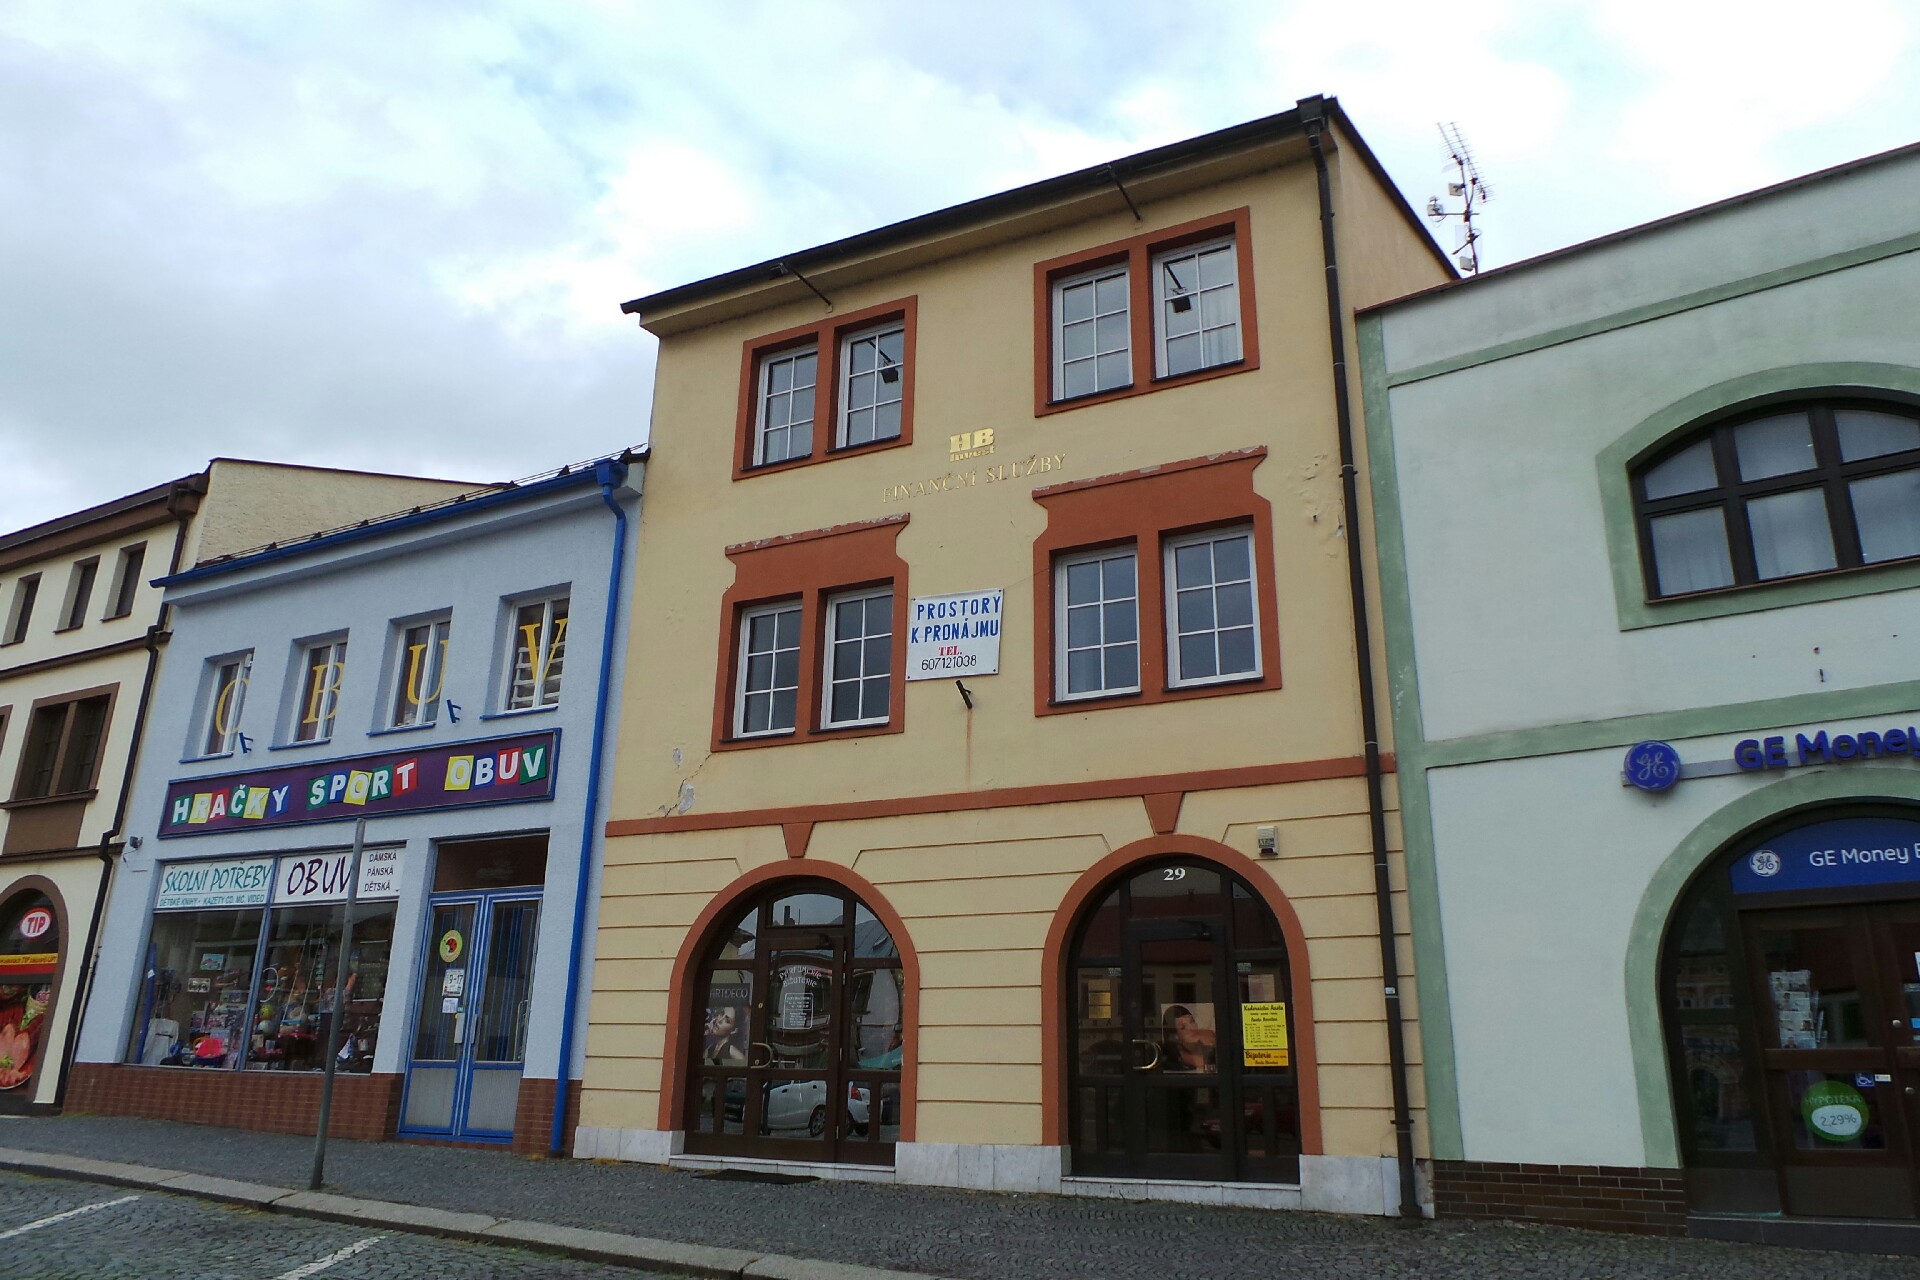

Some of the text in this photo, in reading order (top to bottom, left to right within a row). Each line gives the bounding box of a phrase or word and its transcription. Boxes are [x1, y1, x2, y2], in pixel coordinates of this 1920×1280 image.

[950, 428, 995, 453] HB
[882, 453, 1067, 503] FINANČNÍ SLUŽBY
[917, 596, 1001, 620] PROSTORY
[911, 617, 999, 644] K PRONÁJMU
[938, 645, 963, 656] TEL.
[921, 654, 977, 671] 607121038
[1734, 736, 1788, 770] GE
[171, 747, 545, 824] HRAČKY SPORT OBUV
[369, 849, 397, 862] DÁMSKÁ
[1809, 850, 1837, 867] GE
[1842, 843, 1909, 865] Money
[163, 860, 272, 894] ŠKOLNÍ POTŘEBY
[287, 855, 353, 896] OBUV
[367, 865, 394, 877] PÁNSKÁ
[1163, 867, 1186, 881] 29
[363, 880, 391, 893] DĚTSKÁ
[27, 916, 46, 934] TIP
[710, 988, 748, 999] ARTDECO
[1820, 1113, 1857, 1127] 2,29%
